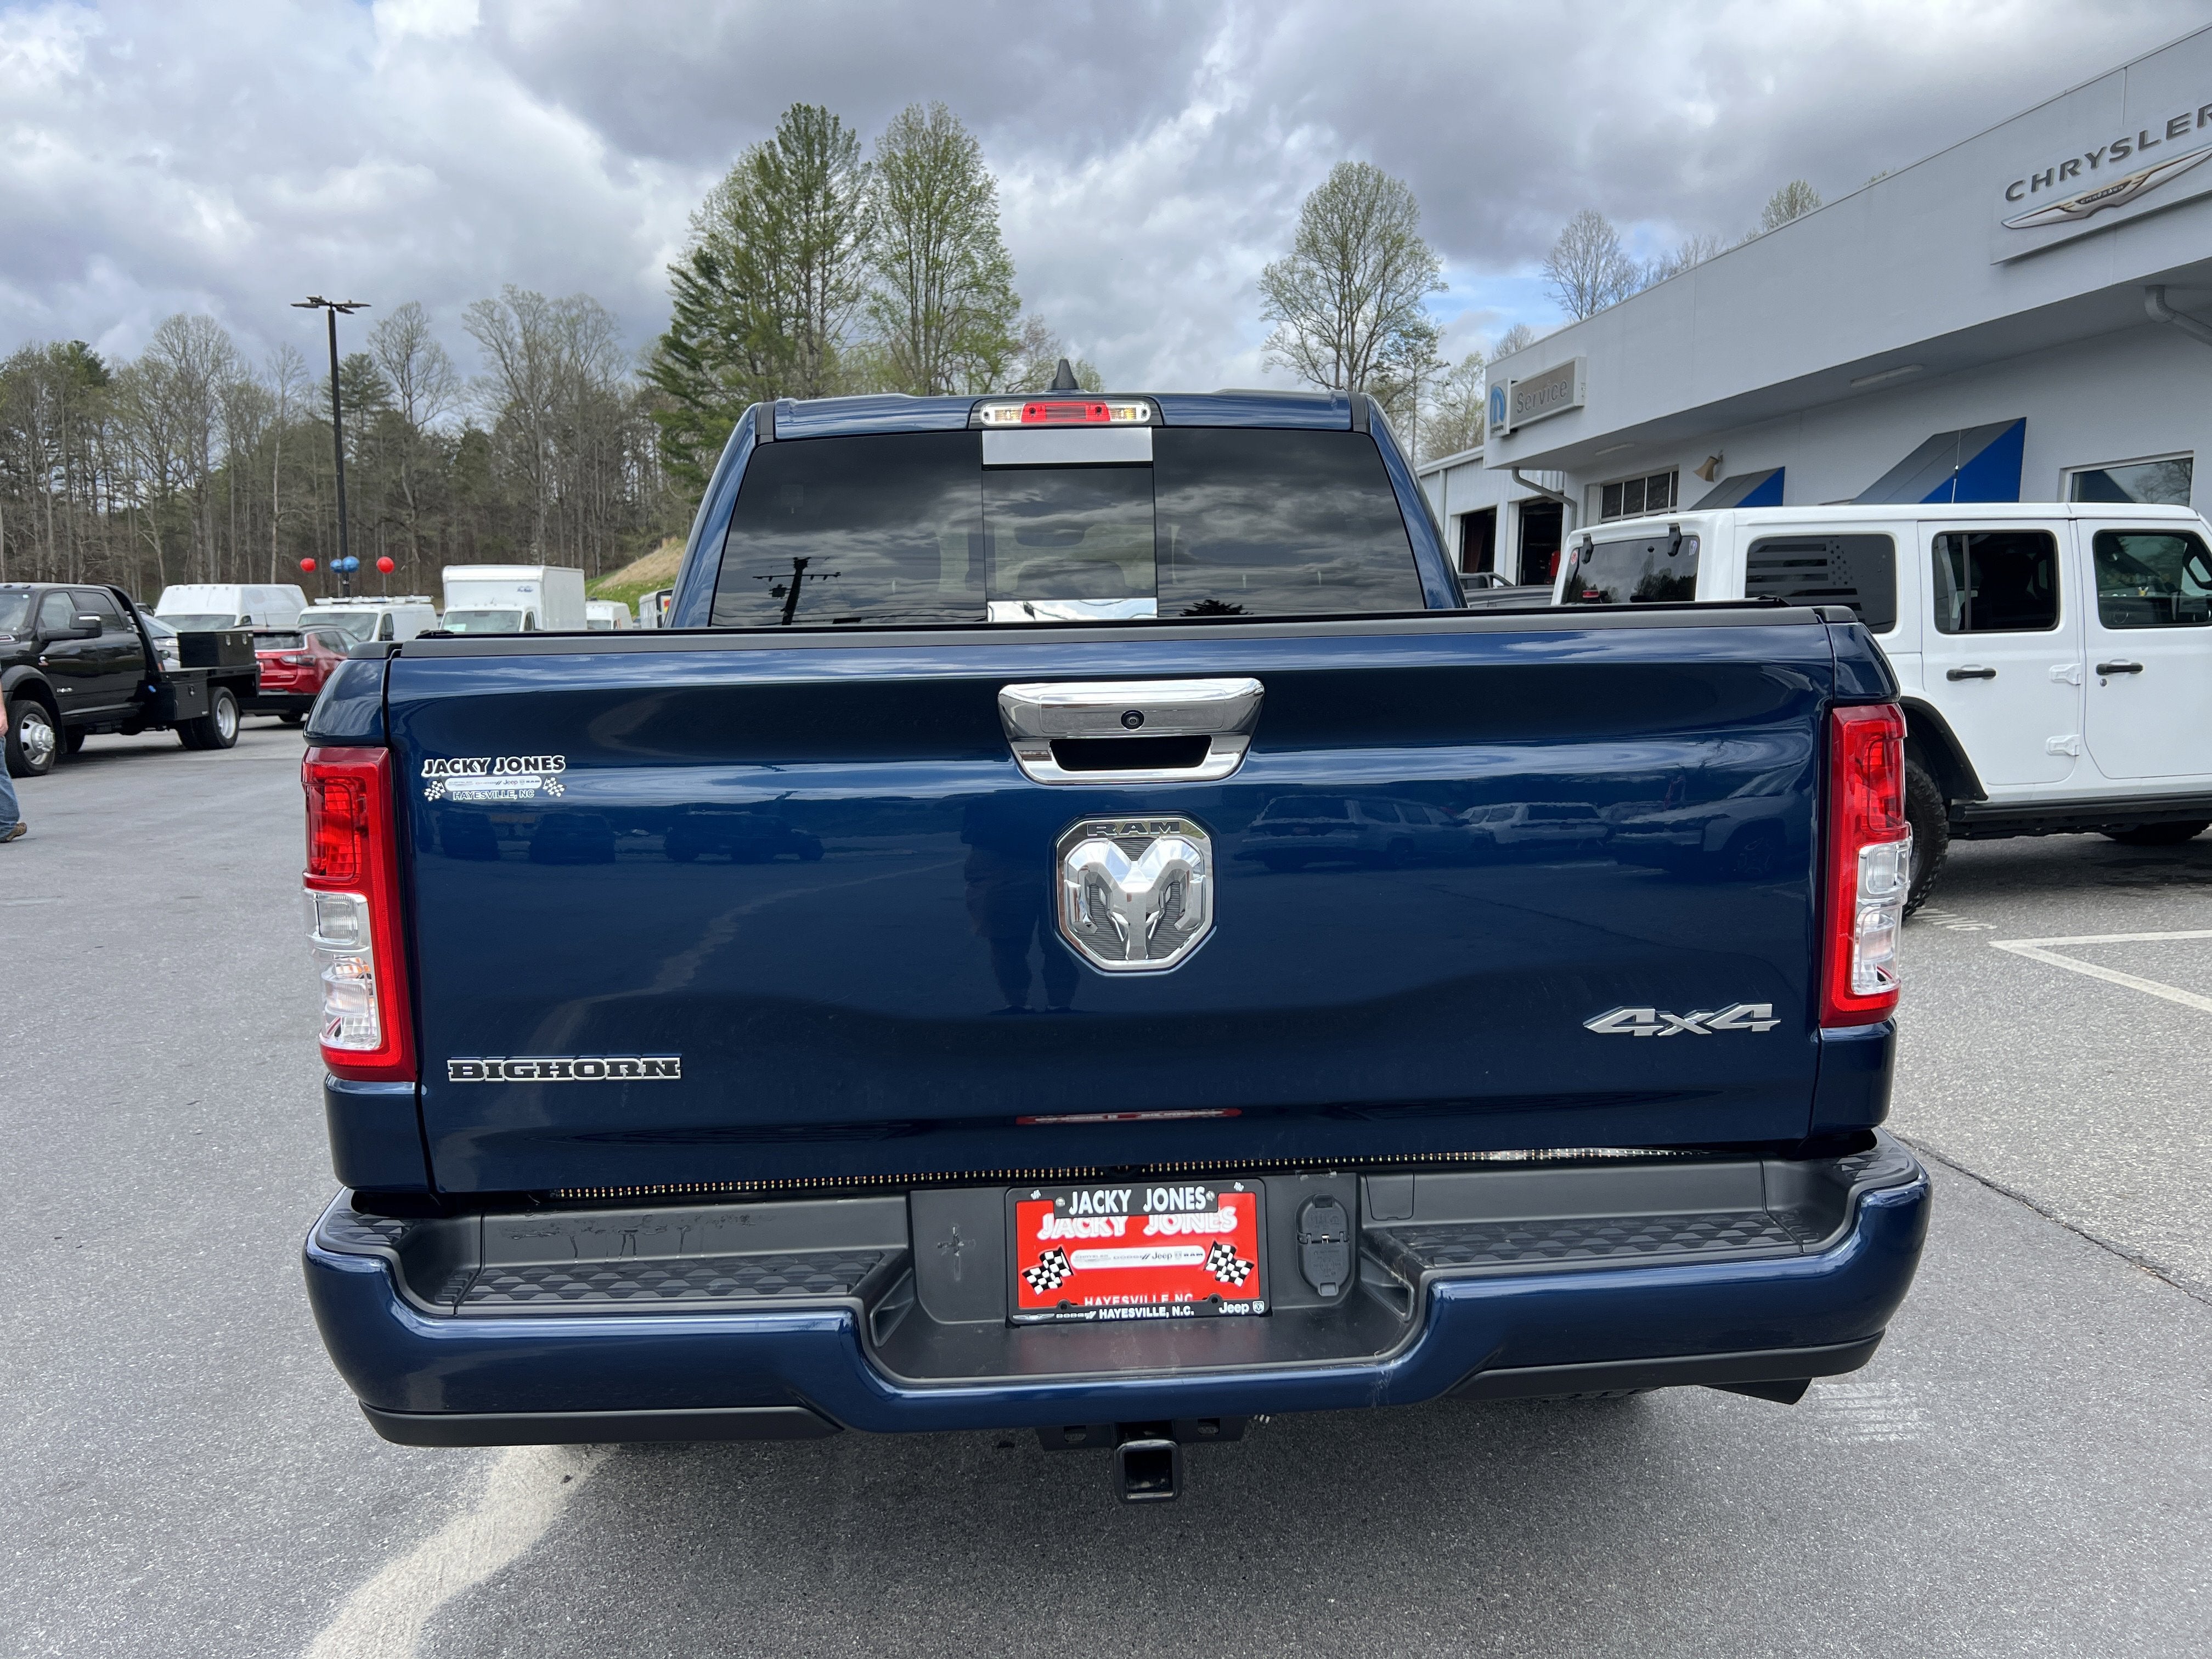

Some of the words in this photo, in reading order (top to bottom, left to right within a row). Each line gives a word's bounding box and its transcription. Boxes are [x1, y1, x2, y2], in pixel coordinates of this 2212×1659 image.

[1516, 380, 1568, 414] Service
[421, 757, 491, 777] JACKY
[493, 755, 566, 775] JONES
[453, 791, 517, 800] HAYESVILLE,
[519, 789, 535, 798] NC
[1087, 822, 1180, 836] RAM
[447, 1057, 681, 1081] BIGHORN
[1069, 1188, 1132, 1215] JACKY
[1143, 1186, 1206, 1212] JONES
[1037, 1213, 1128, 1240] JACKY
[1143, 1206, 1238, 1235] JONES
[1152, 1251, 1172, 1260] Jeep
[1099, 1307, 1170, 1319] HAYESVILLE,
[1172, 1305, 1195, 1316] N.C.
[1218, 1302, 1250, 1315] Jeep
